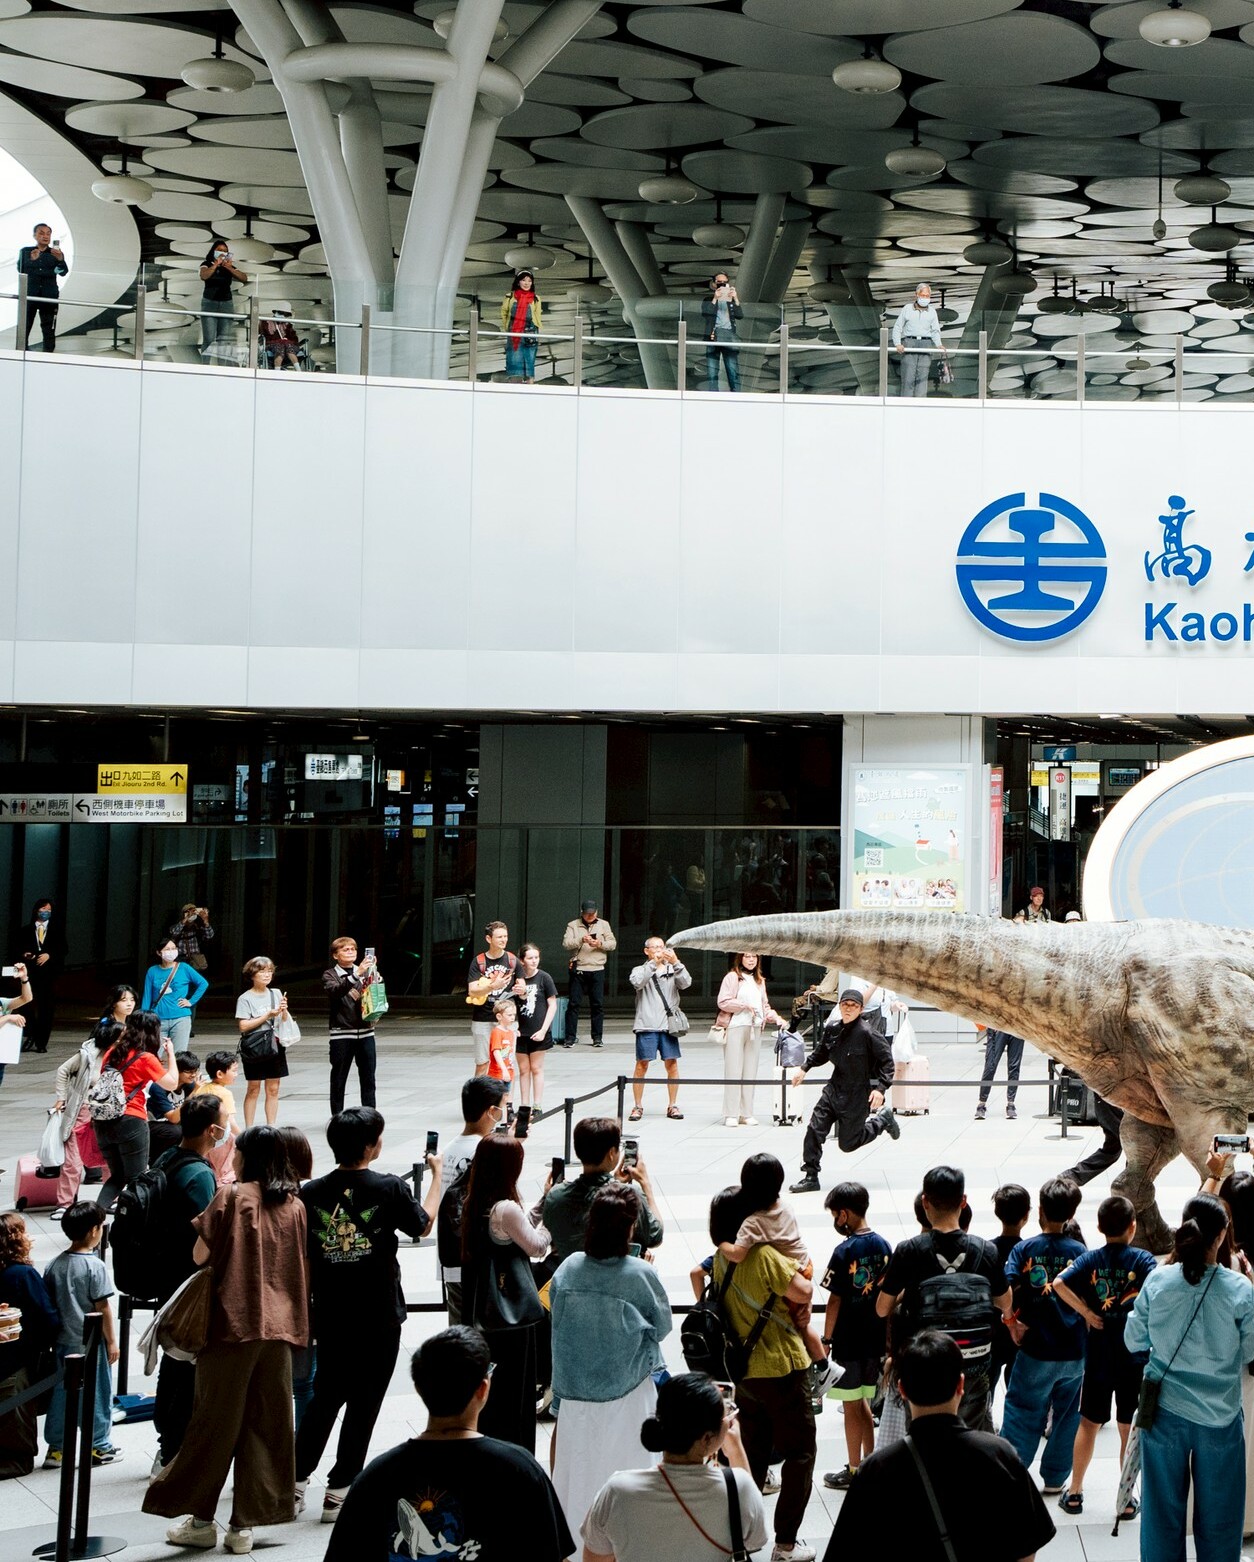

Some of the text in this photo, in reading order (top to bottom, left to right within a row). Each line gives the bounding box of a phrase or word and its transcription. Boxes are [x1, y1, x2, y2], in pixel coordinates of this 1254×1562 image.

[48, 799, 69, 810] 廁所
[92, 799, 165, 810] 西側機車停車場
